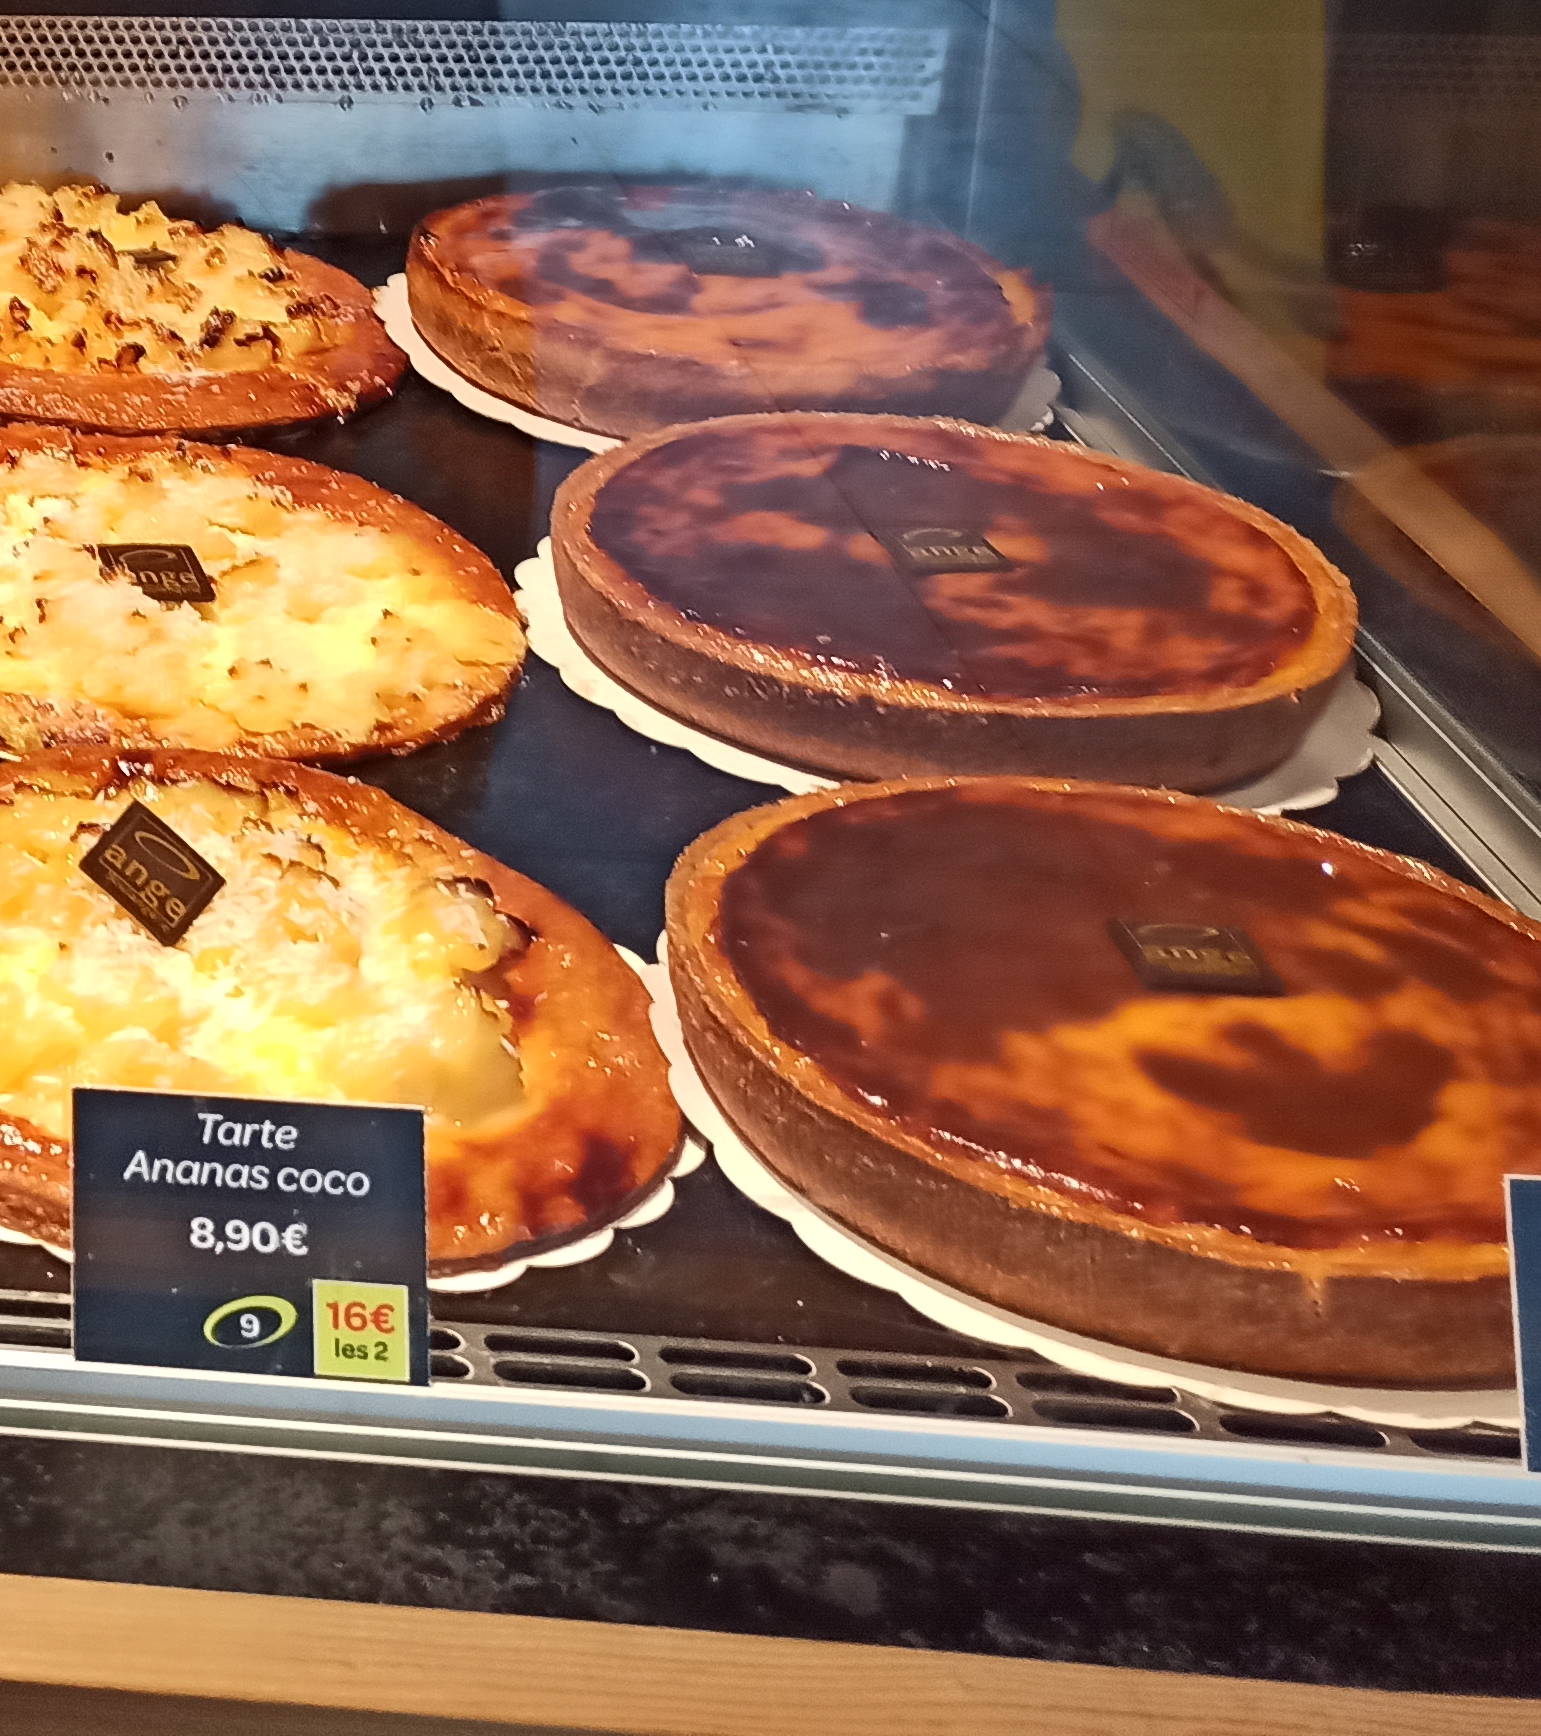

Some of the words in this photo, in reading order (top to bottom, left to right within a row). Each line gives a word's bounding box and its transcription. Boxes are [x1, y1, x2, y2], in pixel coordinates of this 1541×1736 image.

[103, 843, 187, 925] ange
[197, 1112, 299, 1150] Tarte
[123, 1150, 270, 1191] Ananas
[277, 1166, 371, 1197] coco
[189, 1216, 309, 1256] 8,90€
[239, 1312, 261, 1339] 9
[325, 1300, 396, 1334] 16€
[334, 1337, 369, 1360] les
[374, 1340, 390, 1362] 2
